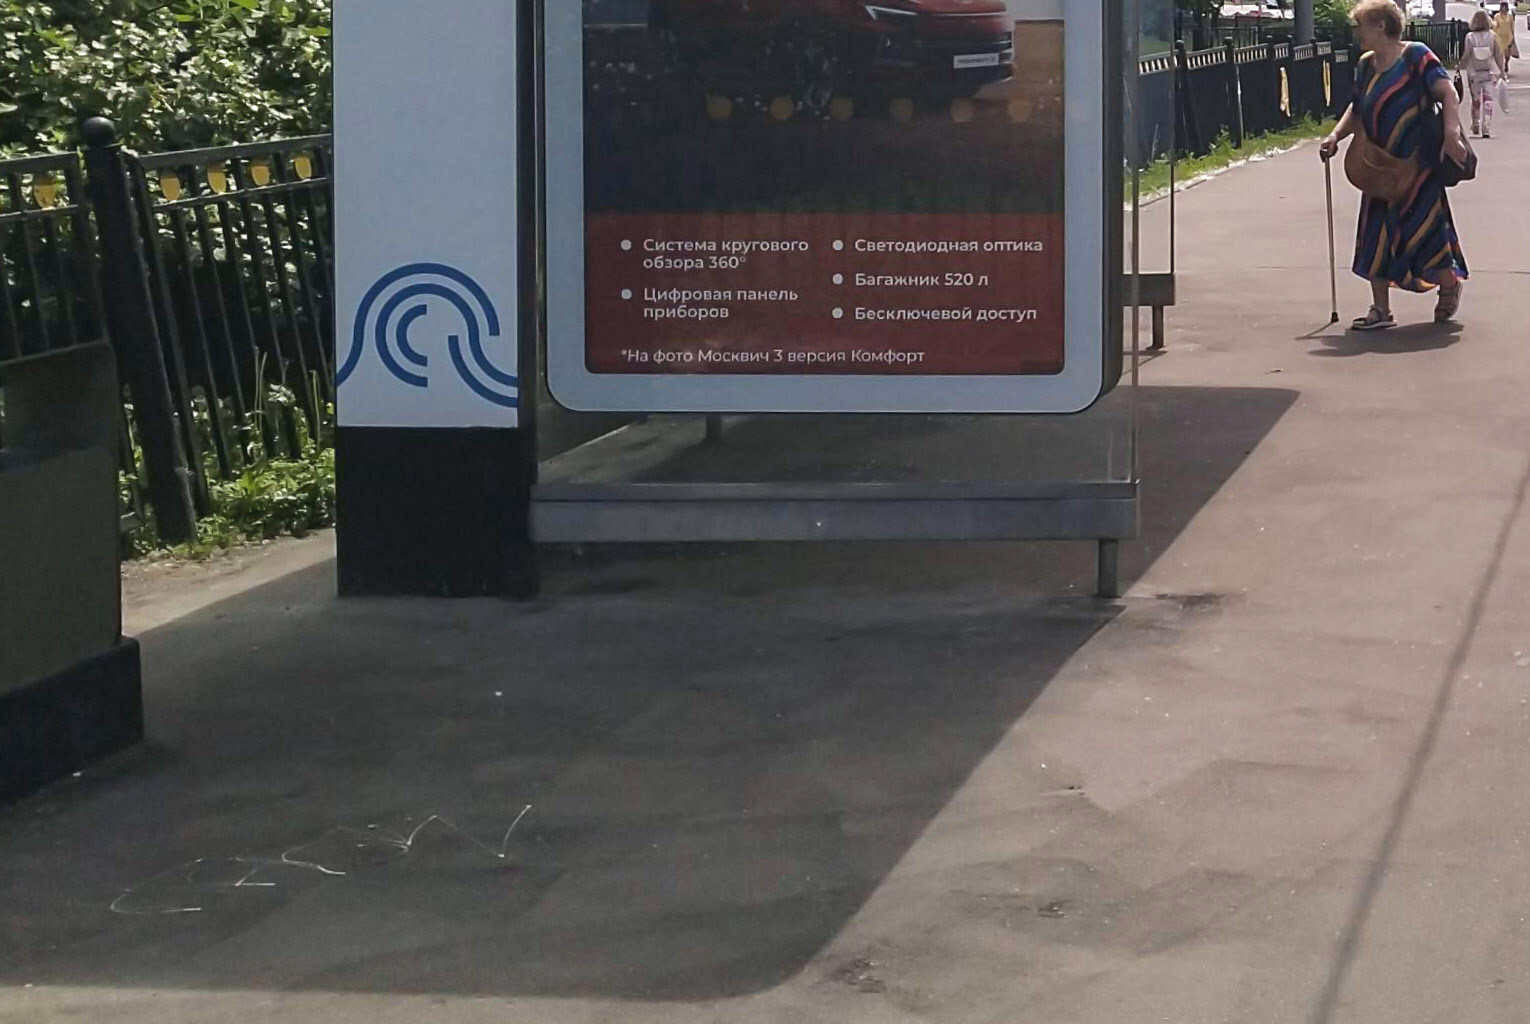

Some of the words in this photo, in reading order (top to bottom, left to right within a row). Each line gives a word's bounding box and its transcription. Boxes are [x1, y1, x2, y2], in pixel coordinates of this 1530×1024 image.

[643, 239, 717, 252] Система
[722, 241, 809, 254] кругового
[855, 239, 978, 253] Светодиодная
[983, 241, 1044, 252] оптика
[643, 256, 704, 271] обзора
[855, 273, 940, 286] Багажник
[944, 273, 974, 286] 520
[977, 275, 989, 286] л
[643, 287, 732, 303] Цифровая
[737, 289, 799, 301] панель
[643, 305, 730, 320] приборов
[855, 307, 972, 320] Бесключевой
[976, 309, 1037, 323] доступ
[653, 349, 693, 364] фото
[698, 349, 769, 362] Москвич
[773, 349, 784, 362] 3
[788, 351, 846, 364] версия
[851, 349, 925, 364] Комфорт
